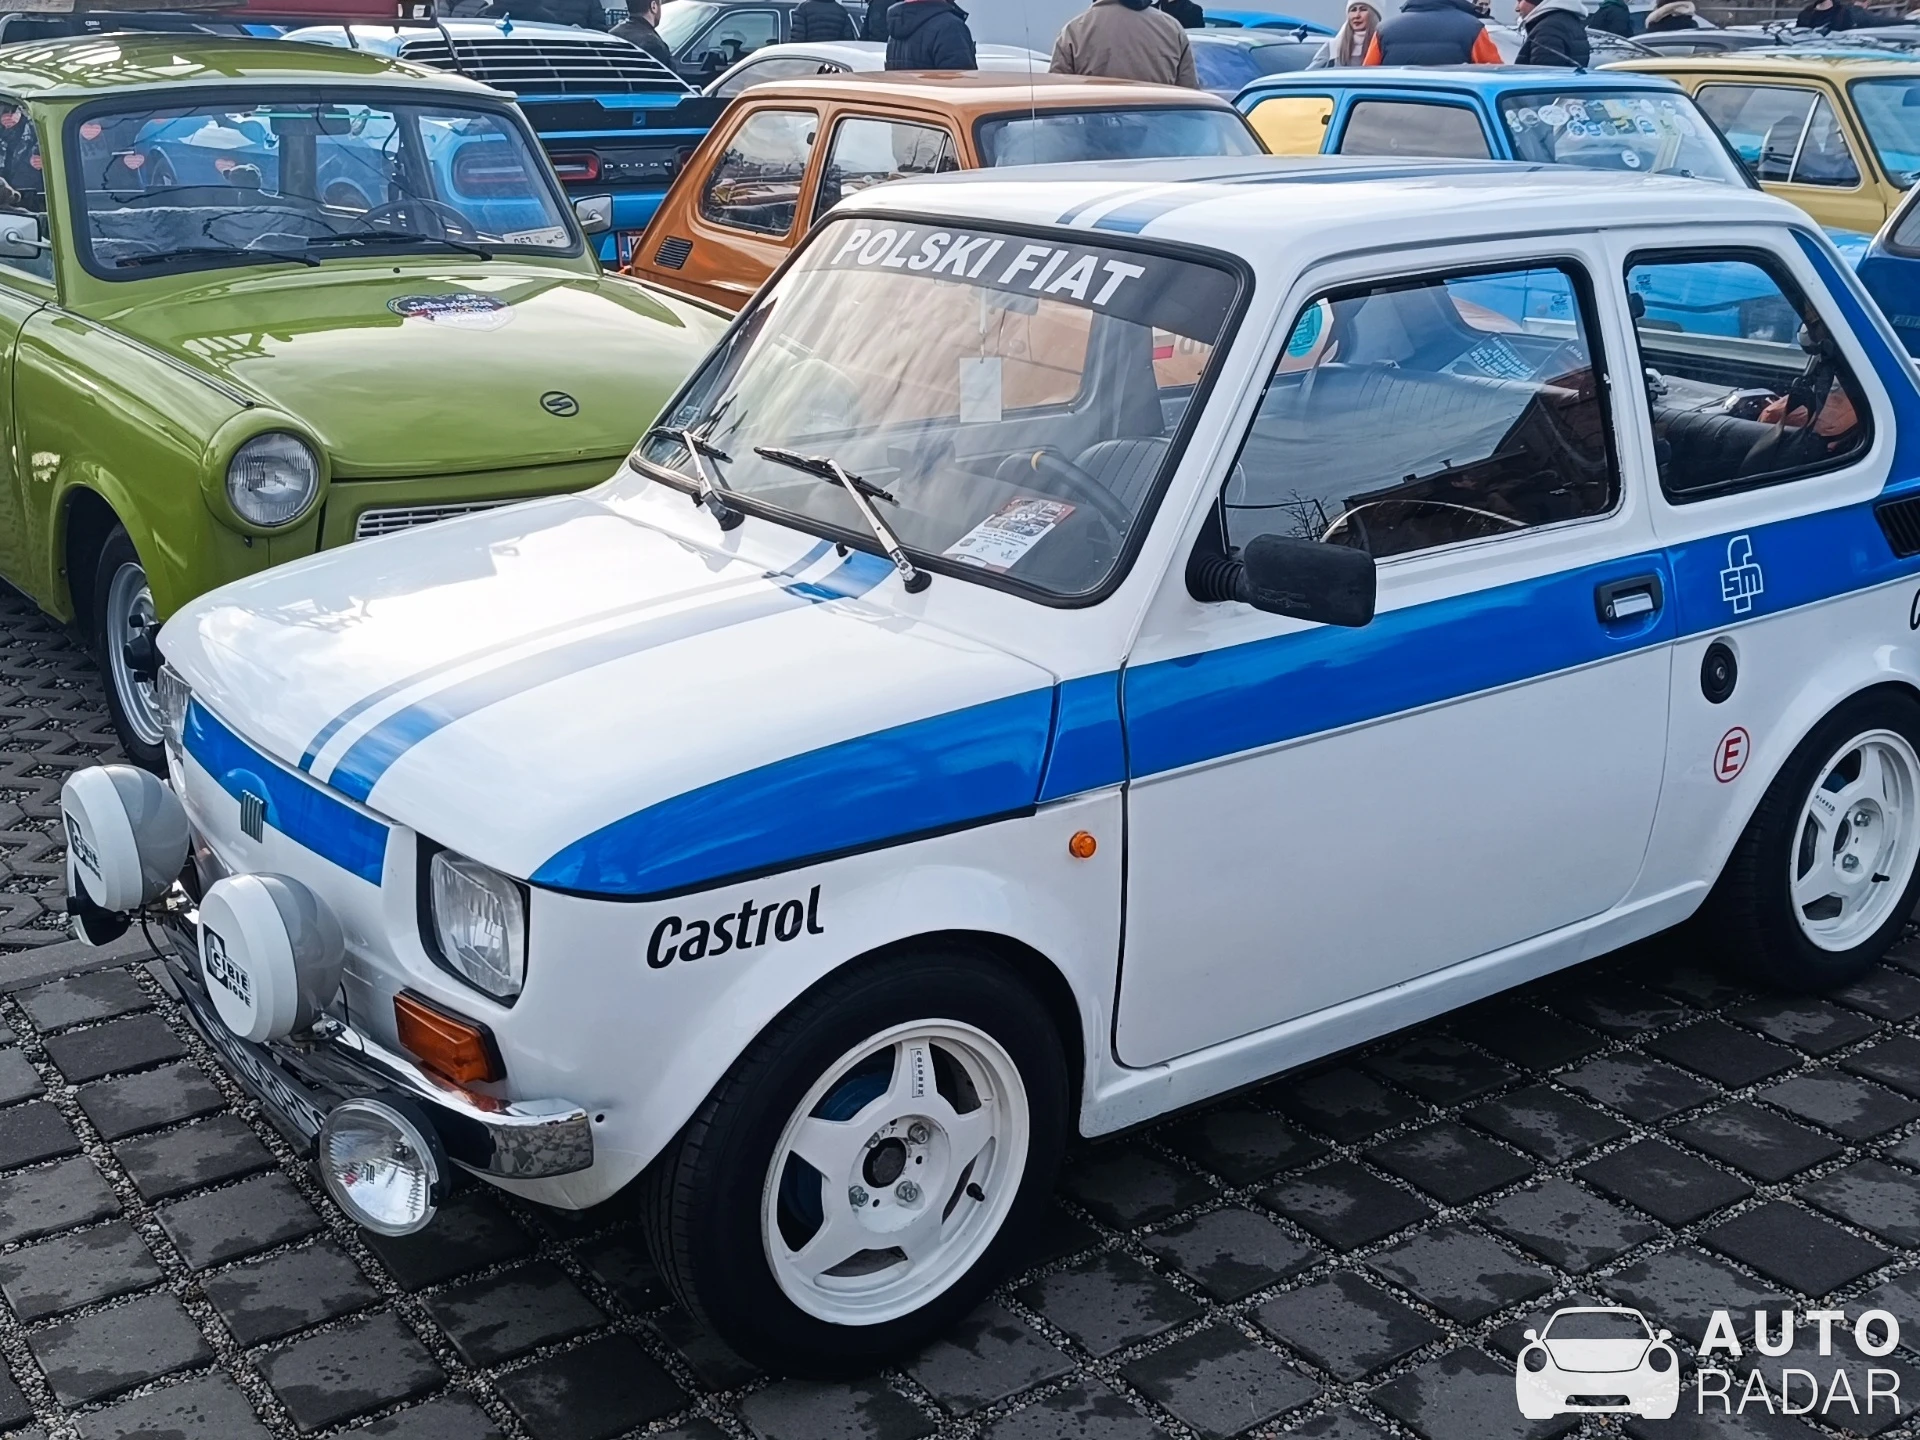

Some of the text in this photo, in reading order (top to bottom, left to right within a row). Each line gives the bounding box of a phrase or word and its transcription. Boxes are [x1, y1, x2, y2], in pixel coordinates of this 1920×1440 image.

[830, 228, 1146, 306] POLSKI FIAT
[1721, 736, 1742, 773] E
[646, 884, 824, 969] Castrol
